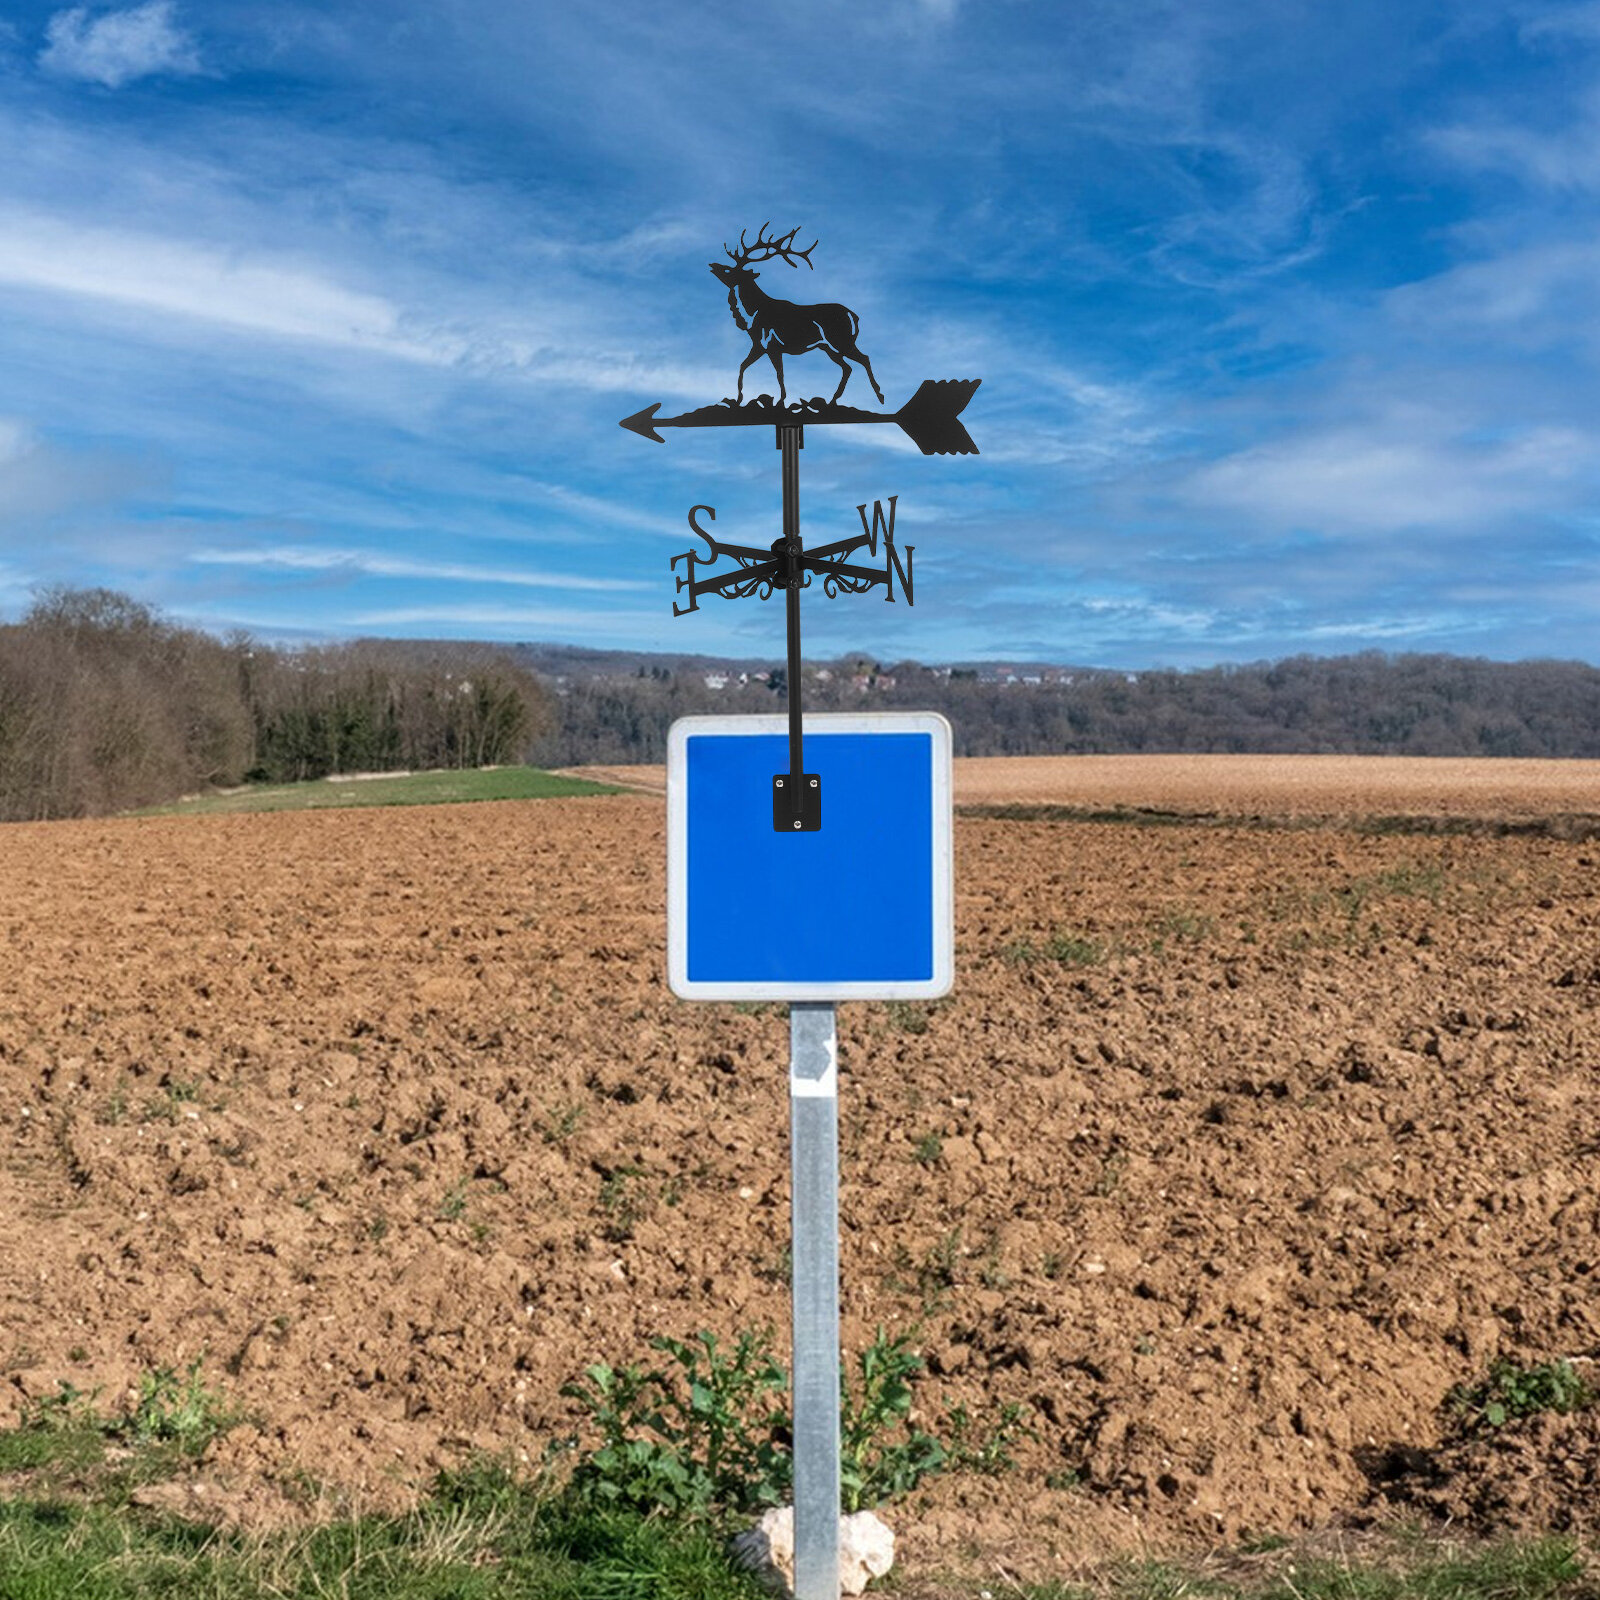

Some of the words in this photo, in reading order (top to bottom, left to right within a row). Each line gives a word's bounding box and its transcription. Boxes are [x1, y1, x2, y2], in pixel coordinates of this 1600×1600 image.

[688, 504, 719, 566] S
[856, 495, 898, 557] W
[883, 541, 915, 606] N
